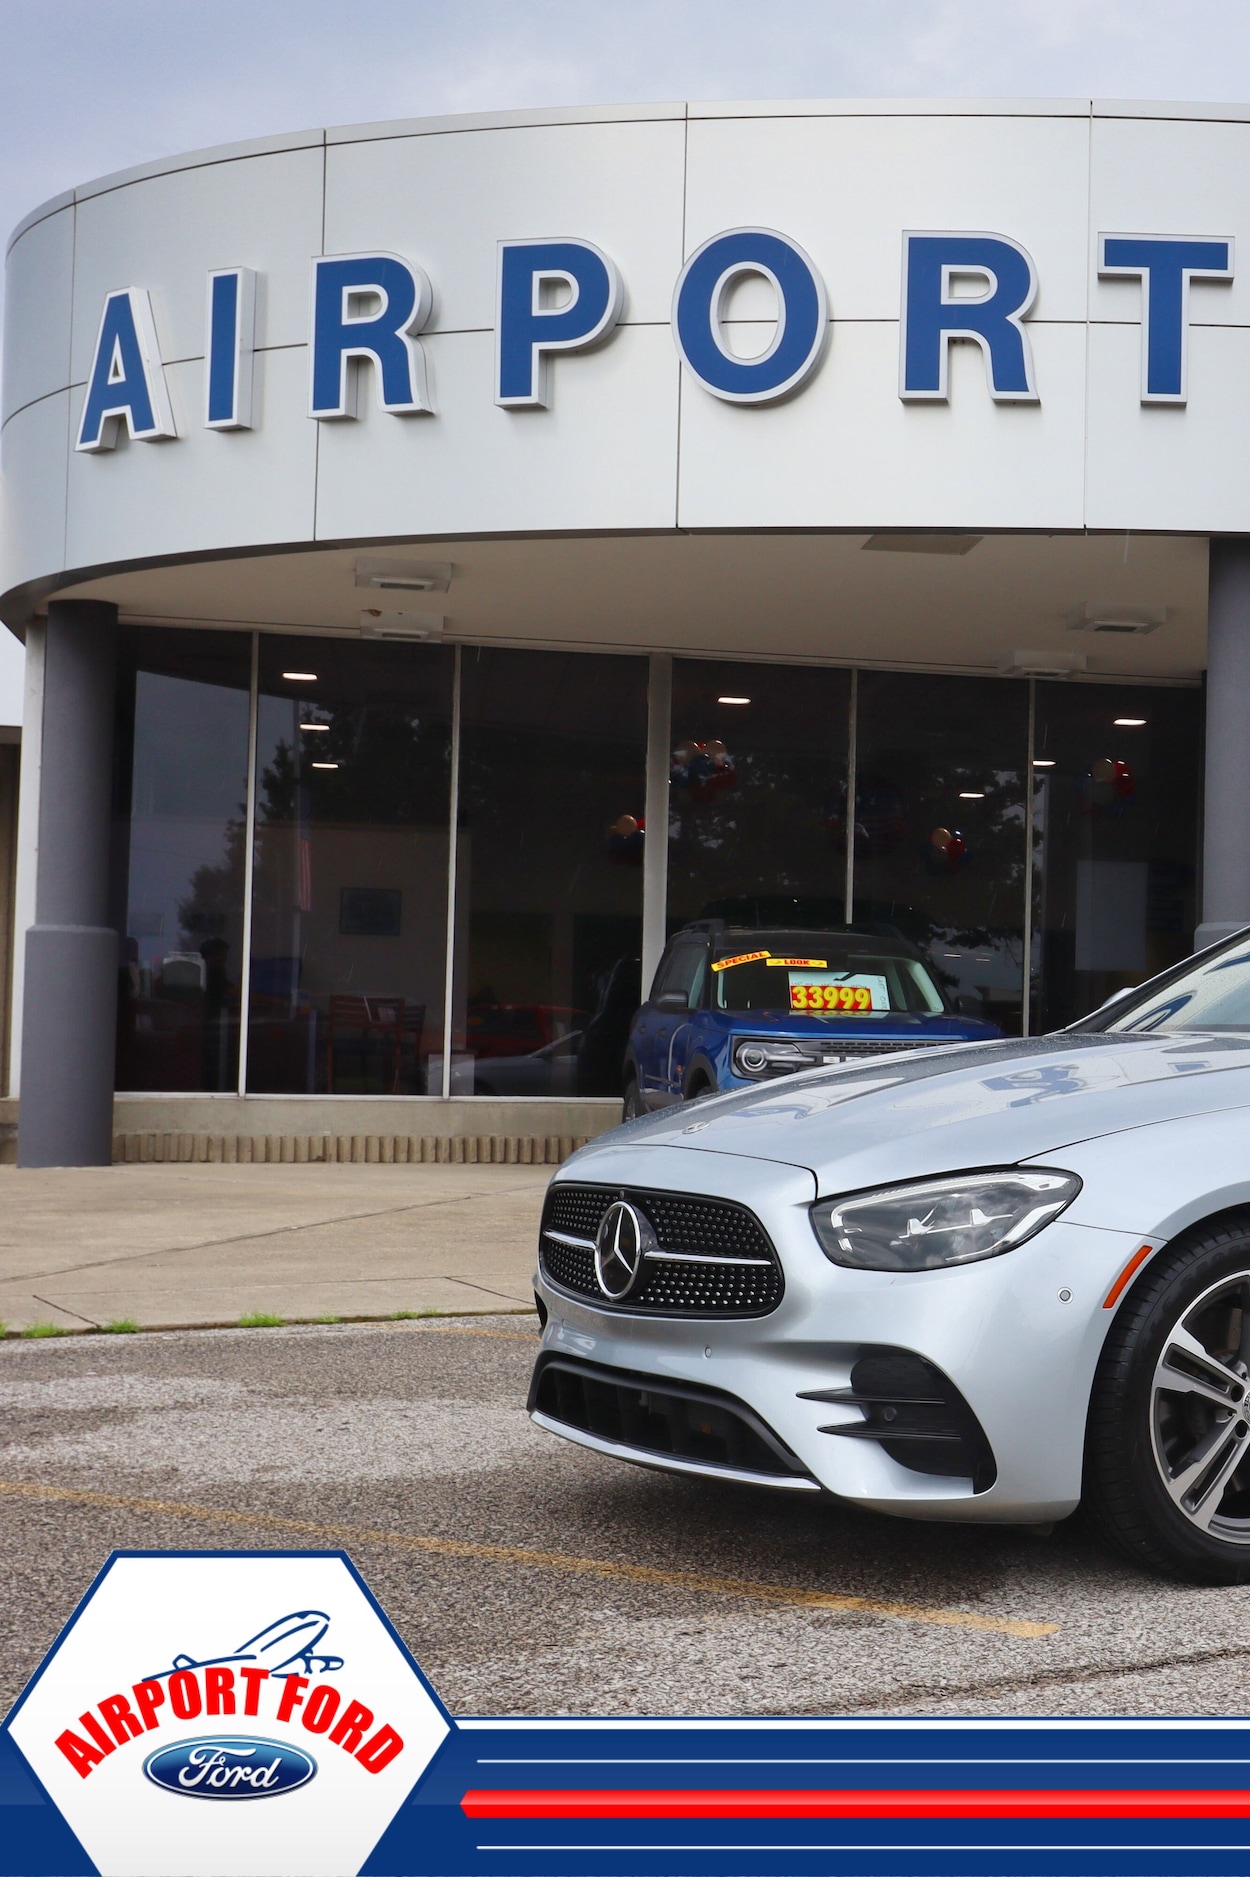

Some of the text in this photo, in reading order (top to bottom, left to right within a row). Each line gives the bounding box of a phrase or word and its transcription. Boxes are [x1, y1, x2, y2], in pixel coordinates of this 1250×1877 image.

[76, 227, 1235, 453] AIRPORT
[716, 952, 767, 969] SPECIAL
[792, 986, 871, 1009] 33999
